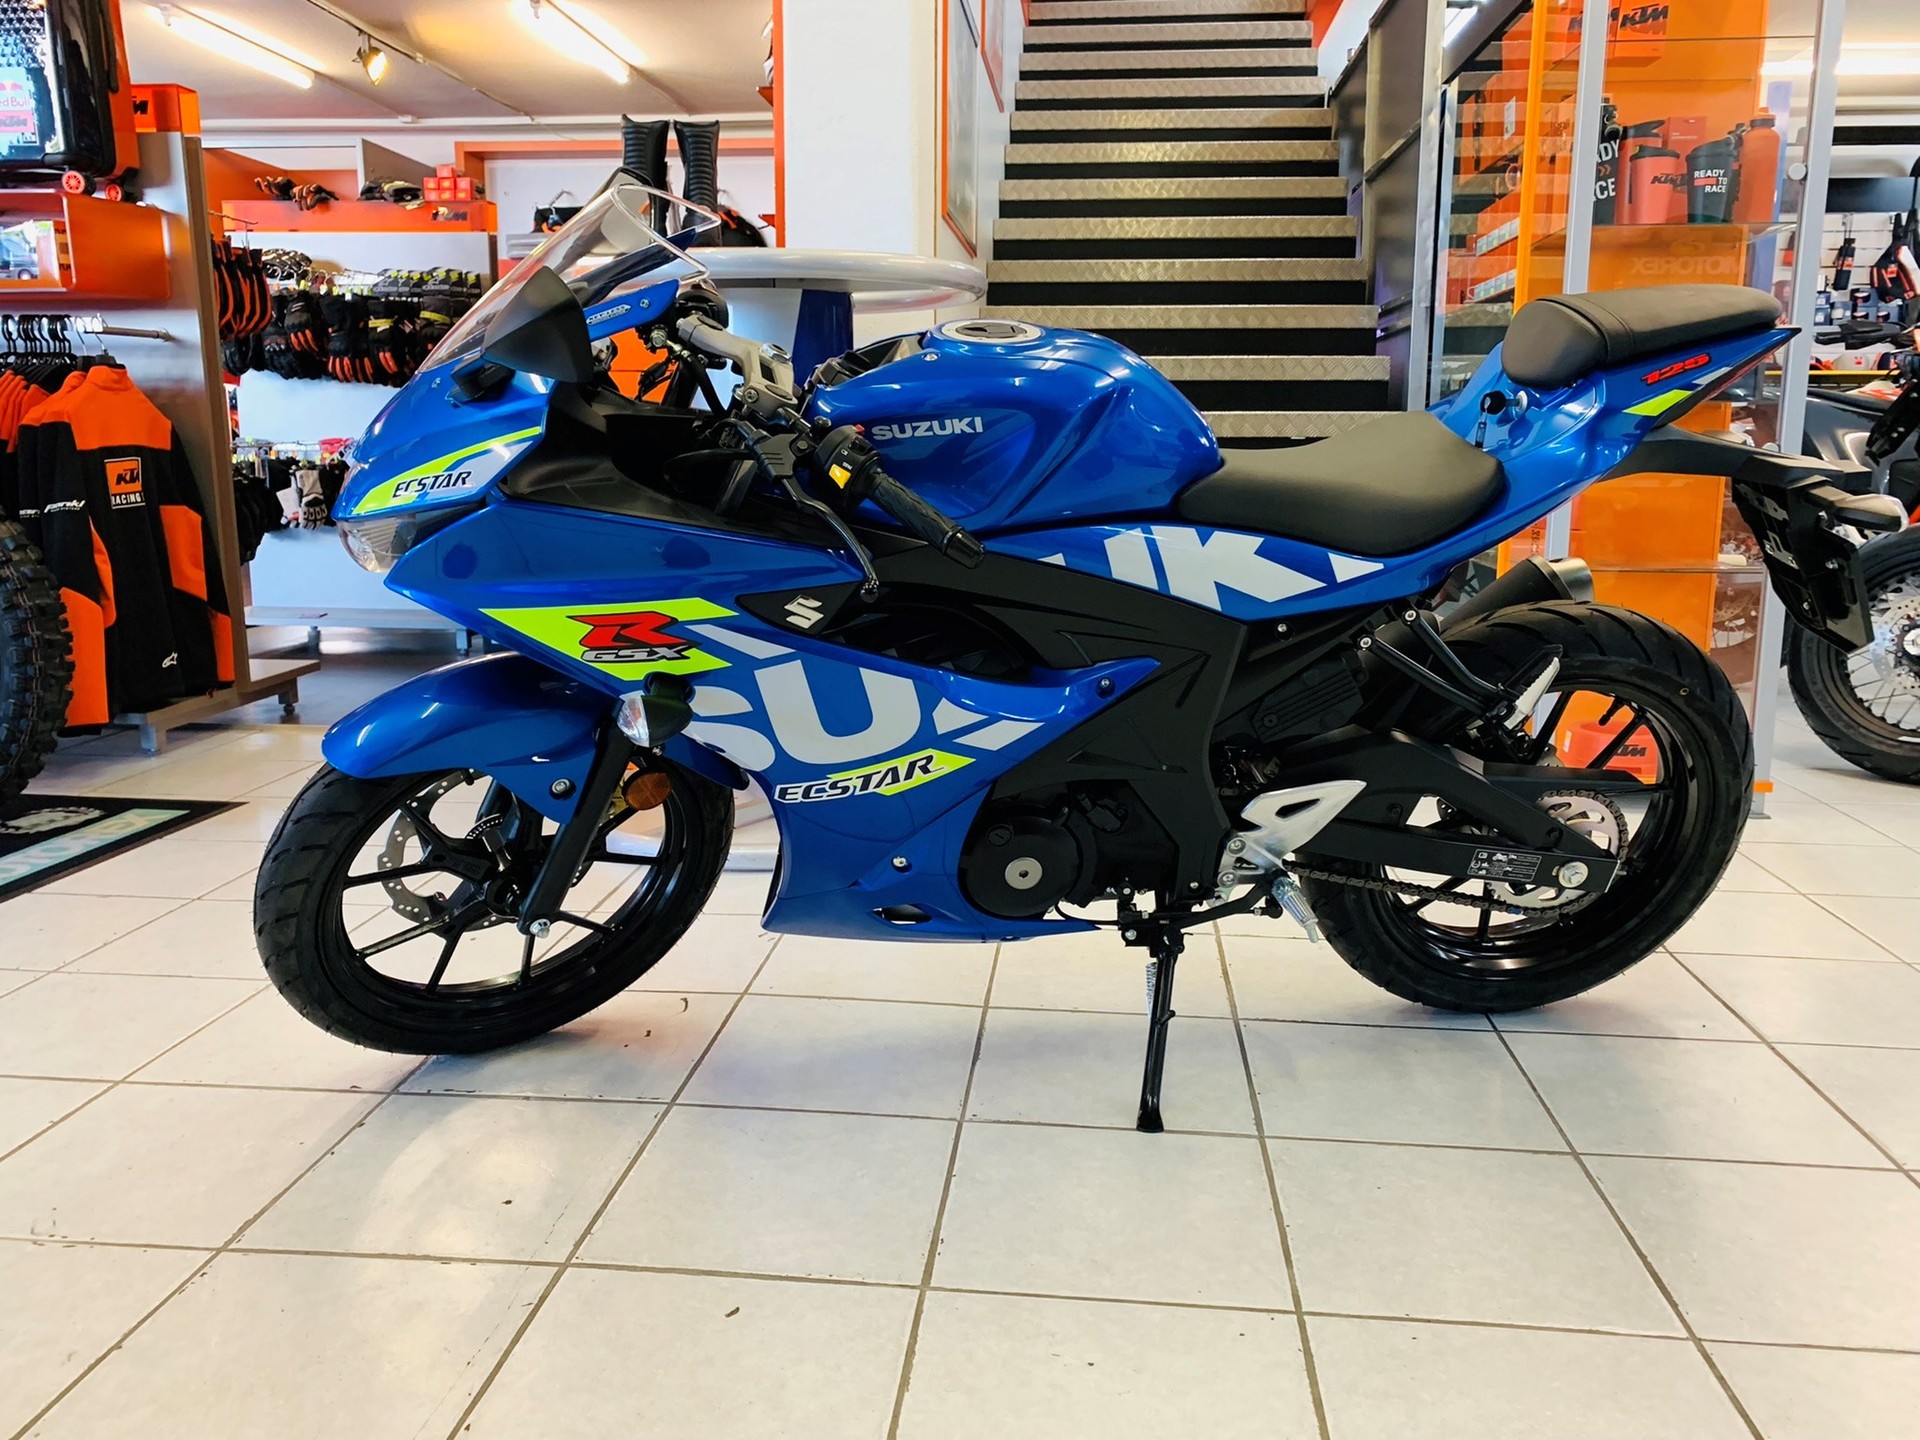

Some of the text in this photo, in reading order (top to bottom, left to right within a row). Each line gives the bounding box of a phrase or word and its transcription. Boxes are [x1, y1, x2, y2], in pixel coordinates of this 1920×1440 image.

[1620, 4, 1669, 29] KTM
[1693, 169, 1725, 179] READY
[1704, 185, 1727, 193] RACE
[1641, 353, 1710, 385] 125
[871, 416, 984, 441] SUZUKI
[392, 471, 472, 498] ECSTAR
[580, 644, 690, 661] GSX
[777, 754, 944, 801] ECSTAR
